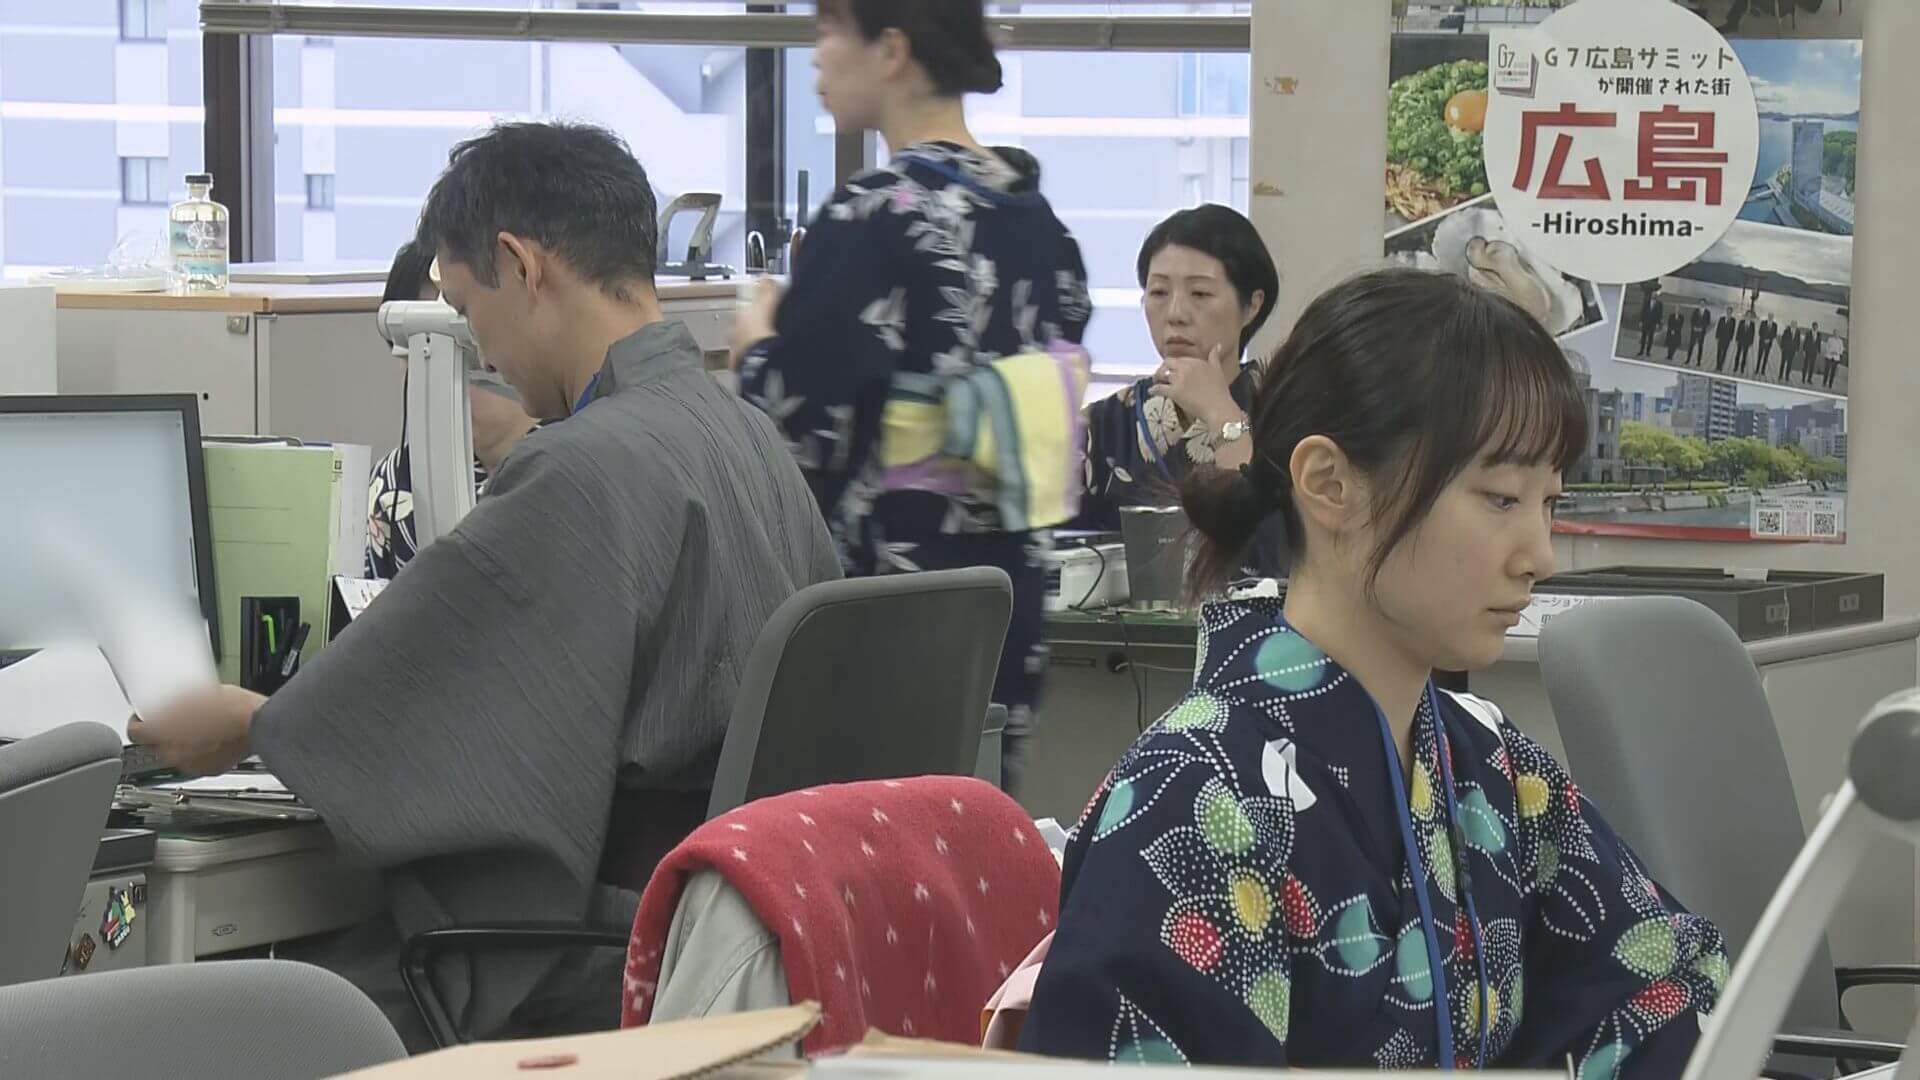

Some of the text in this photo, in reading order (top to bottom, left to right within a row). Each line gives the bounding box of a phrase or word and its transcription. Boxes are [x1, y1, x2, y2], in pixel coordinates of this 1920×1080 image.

[1544, 46, 1734, 70] G7広島サミット
[1598, 77, 1731, 96] が開催された街
[1512, 102, 1728, 205] 広島
[1531, 211, 1704, 236] -Hiroshima-
